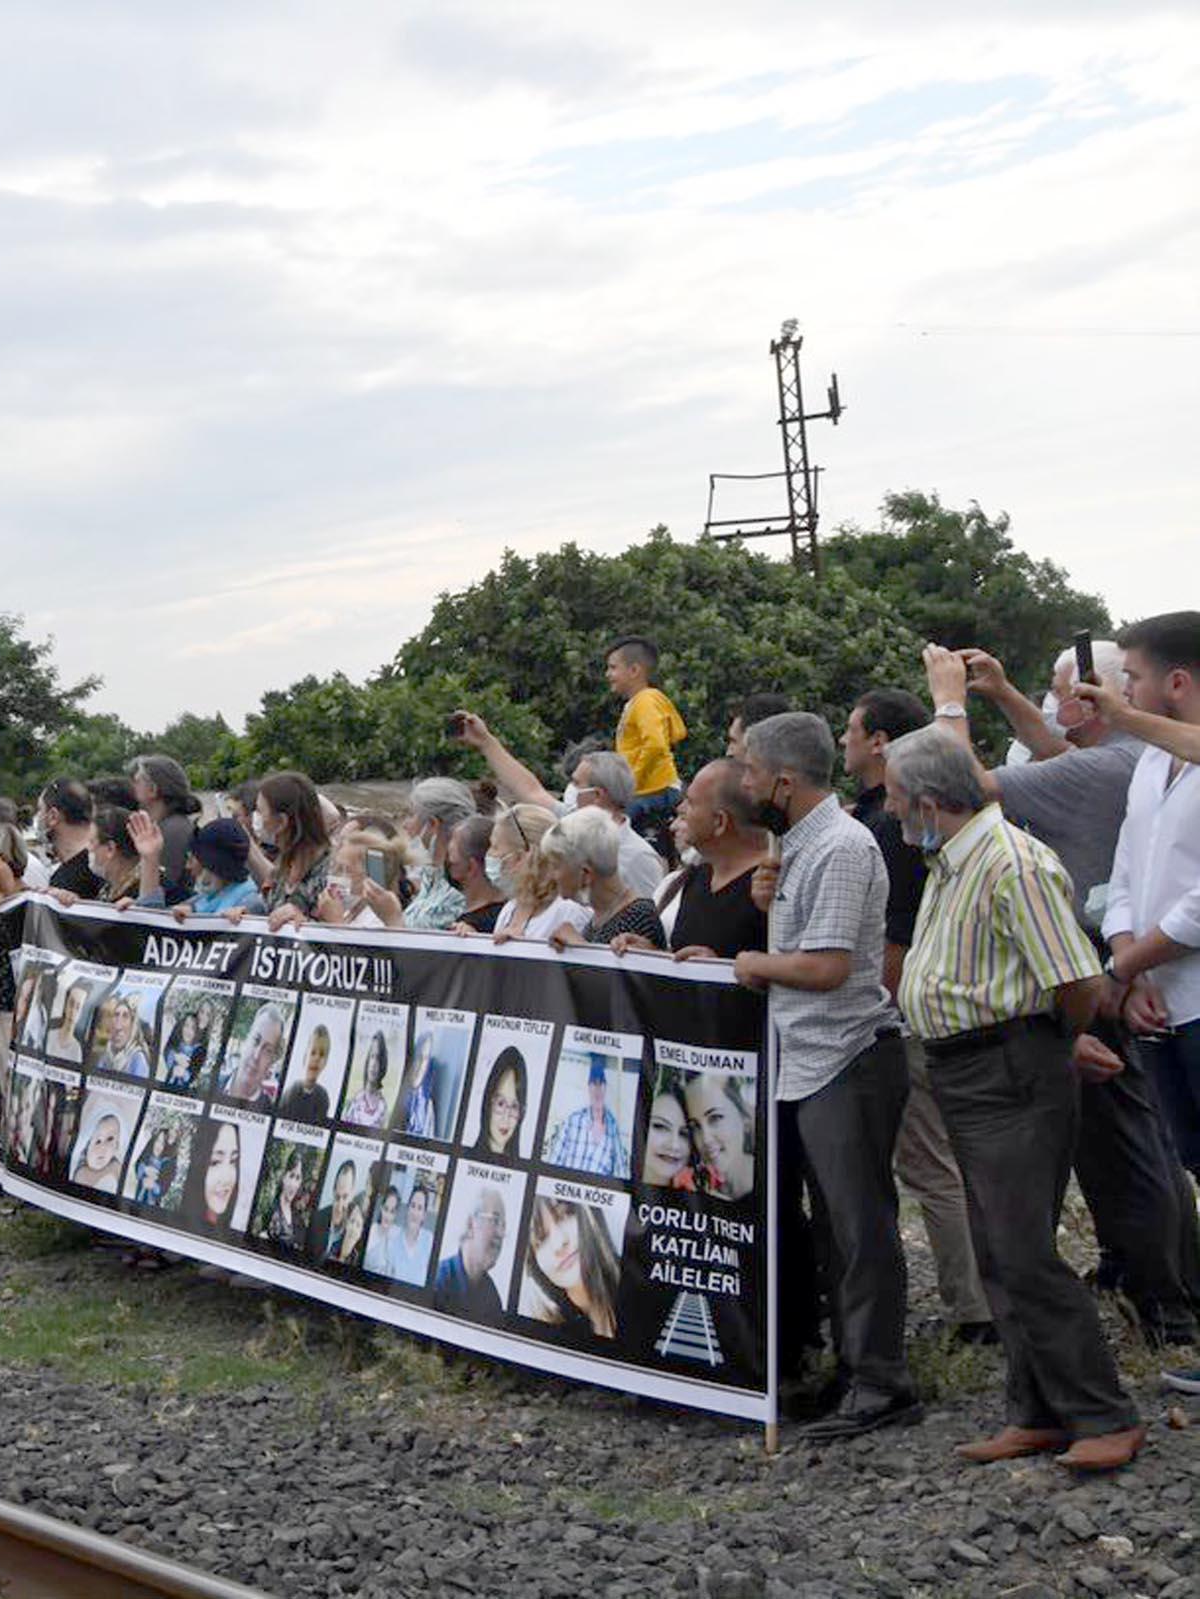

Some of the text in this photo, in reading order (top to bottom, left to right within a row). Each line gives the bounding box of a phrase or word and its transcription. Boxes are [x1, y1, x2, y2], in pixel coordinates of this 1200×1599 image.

[142, 934, 393, 994] ADALET İSTİYORUZ !!!
[659, 1045, 745, 1071] EMEL DUMAN
[553, 1182, 616, 1207] SENA KÖSE
[638, 1203, 755, 1244] ÇORLU TREN
[649, 1259, 741, 1296] AİLELERİ
